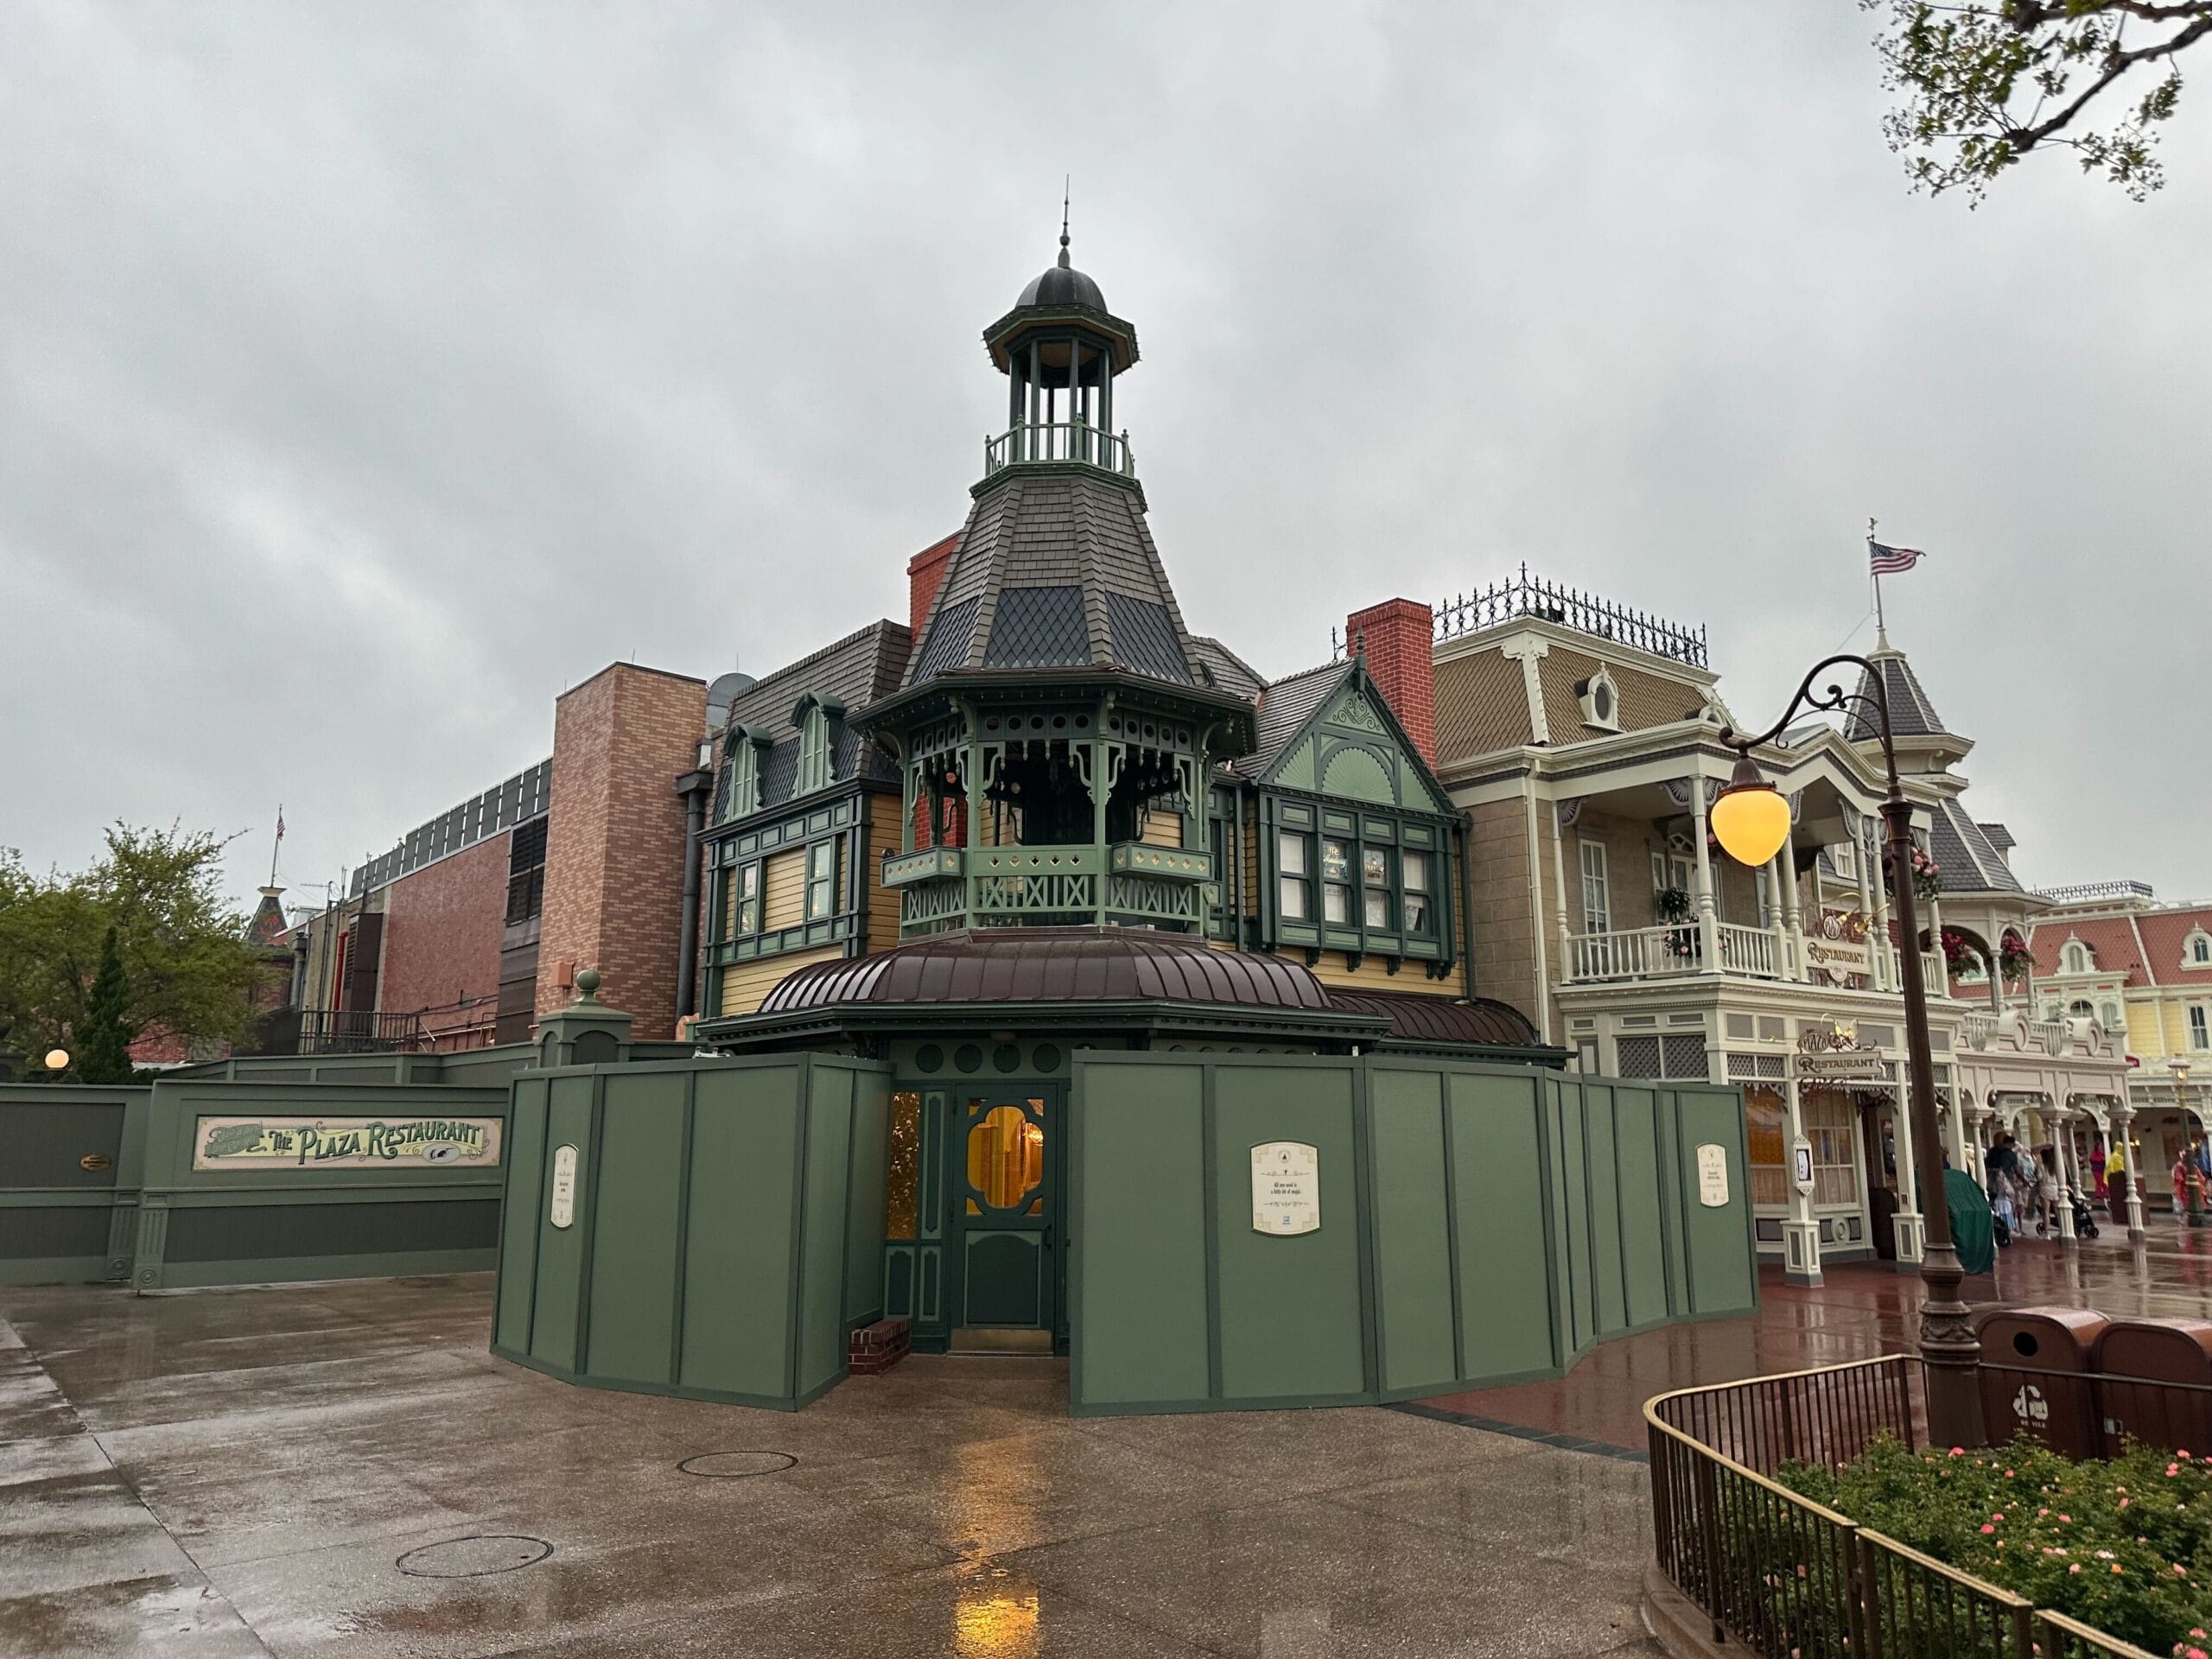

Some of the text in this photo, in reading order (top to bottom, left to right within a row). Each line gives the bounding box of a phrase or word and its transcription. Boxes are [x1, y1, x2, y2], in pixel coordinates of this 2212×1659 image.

[1808, 942, 1865, 963] RESTAURANT
[1798, 1057, 1874, 1073] RESTAURANT
[269, 1130, 293, 1151] THE
[297, 1126, 361, 1165] PLAZA
[365, 1121, 481, 1160] RESTAURANT
